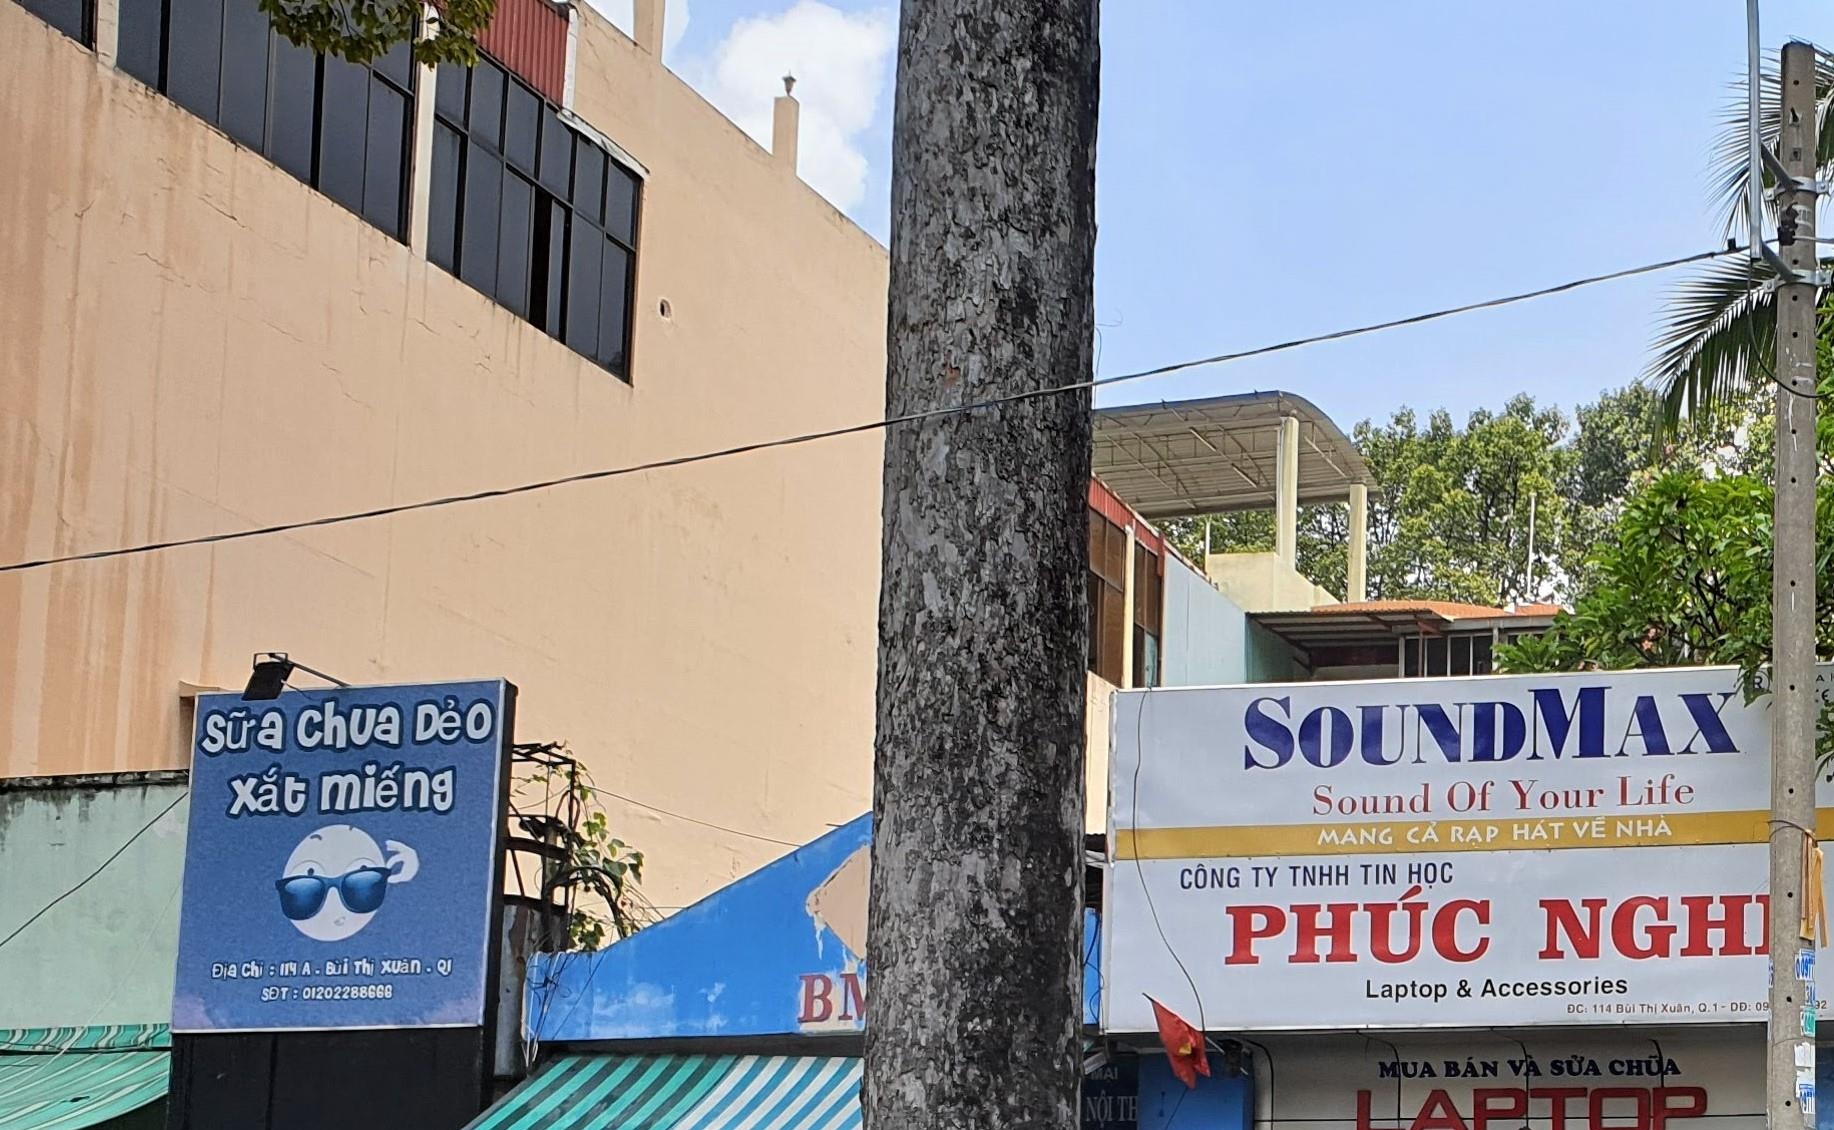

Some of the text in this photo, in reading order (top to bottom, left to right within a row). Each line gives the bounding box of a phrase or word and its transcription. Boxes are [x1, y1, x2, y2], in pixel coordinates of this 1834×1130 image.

[203, 711, 283, 753] Sữa
[321, 763, 453, 810] miếng
[1313, 773, 1695, 815] Sound Of Your Life
[1317, 827, 1393, 845] MANG
[1450, 826, 1499, 849] RẠP
[1513, 818, 1564, 840] HÁT
[1617, 813, 1673, 837] NHÀ
[1180, 862, 1454, 890] CÔNG TY TNHH TIN HỌC
[1225, 885, 1491, 965] PHÚC
[1366, 976, 1628, 1003] Laptop & Accessories
[1593, 1003, 1612, 1013] 114
[1379, 1062, 1436, 1078] MUA
[1445, 1057, 1497, 1077] BÁN
[1508, 1055, 1542, 1076] VÀ
[1550, 1053, 1601, 1076] SỬA
